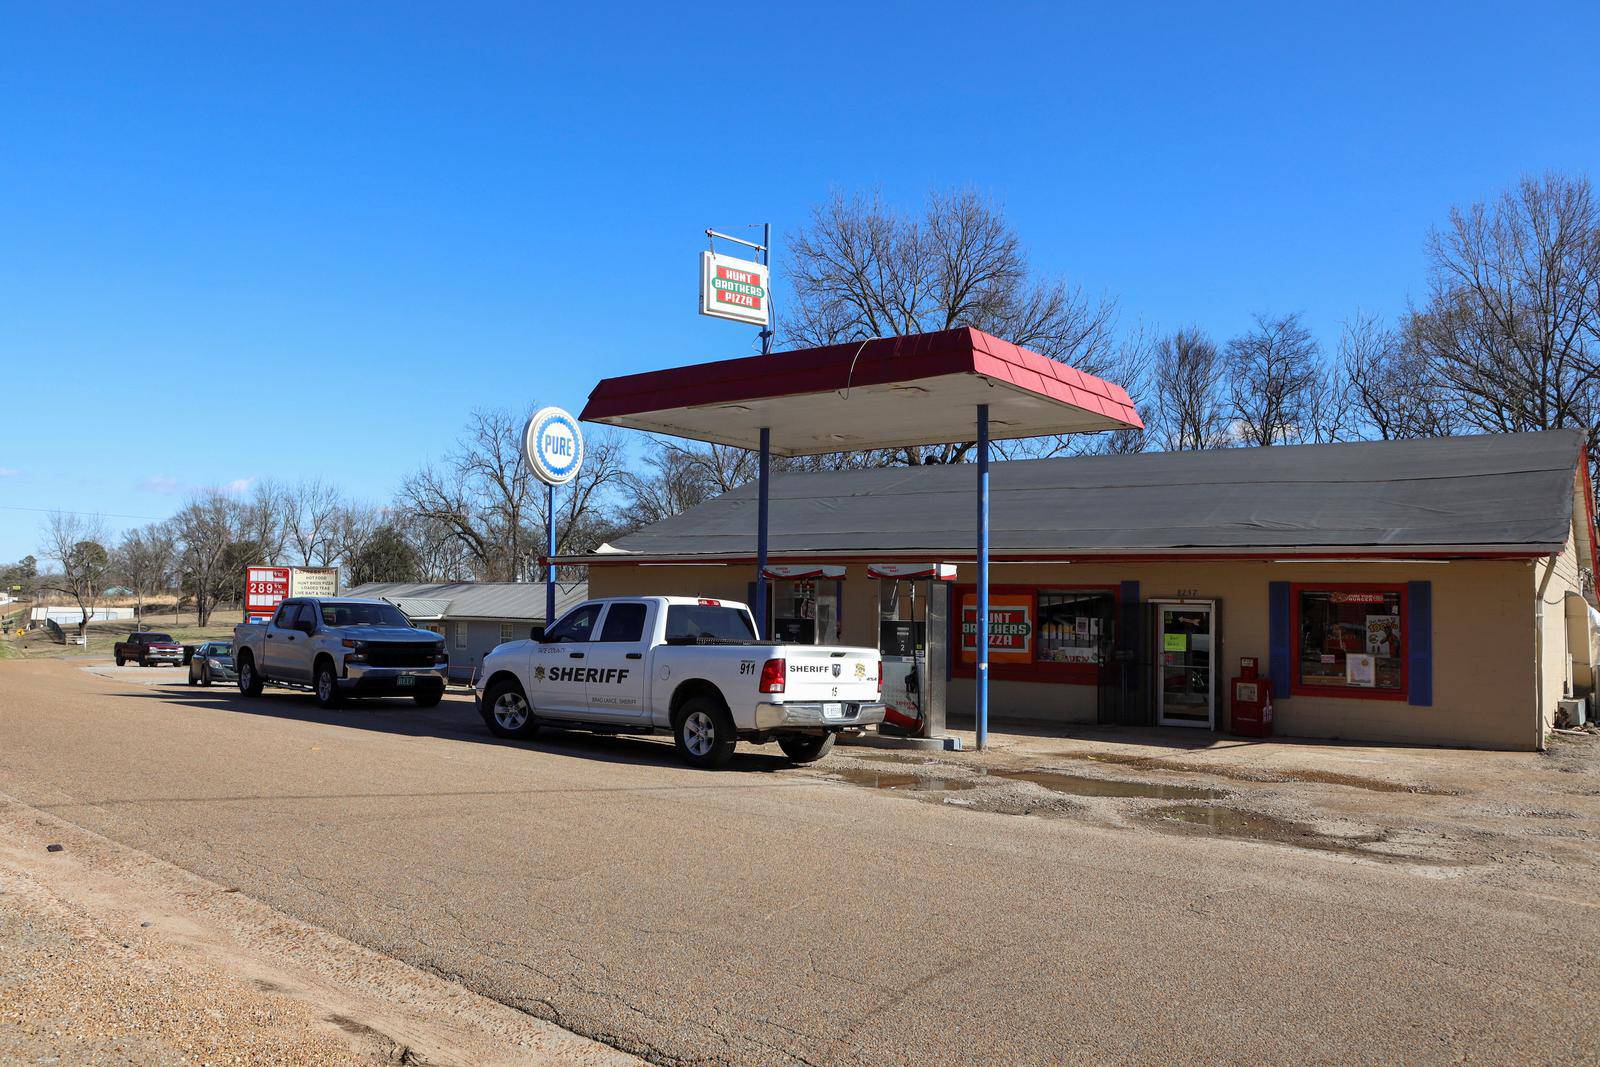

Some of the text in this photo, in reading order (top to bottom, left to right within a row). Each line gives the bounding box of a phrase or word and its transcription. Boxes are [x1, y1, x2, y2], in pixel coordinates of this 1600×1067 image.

[726, 269, 752, 284] HUNT
[715, 279, 762, 297] BROTHERS
[725, 292, 753, 306] PIZZA
[545, 434, 572, 457] PURE
[250, 583, 273, 594] 289
[976, 612, 1011, 623] UNT
[962, 623, 1027, 635] BRTHERS
[548, 666, 629, 684] SHERIFF
[740, 663, 755, 675] 911
[790, 665, 829, 673] SHERIFF
[831, 686, 838, 697] 15
